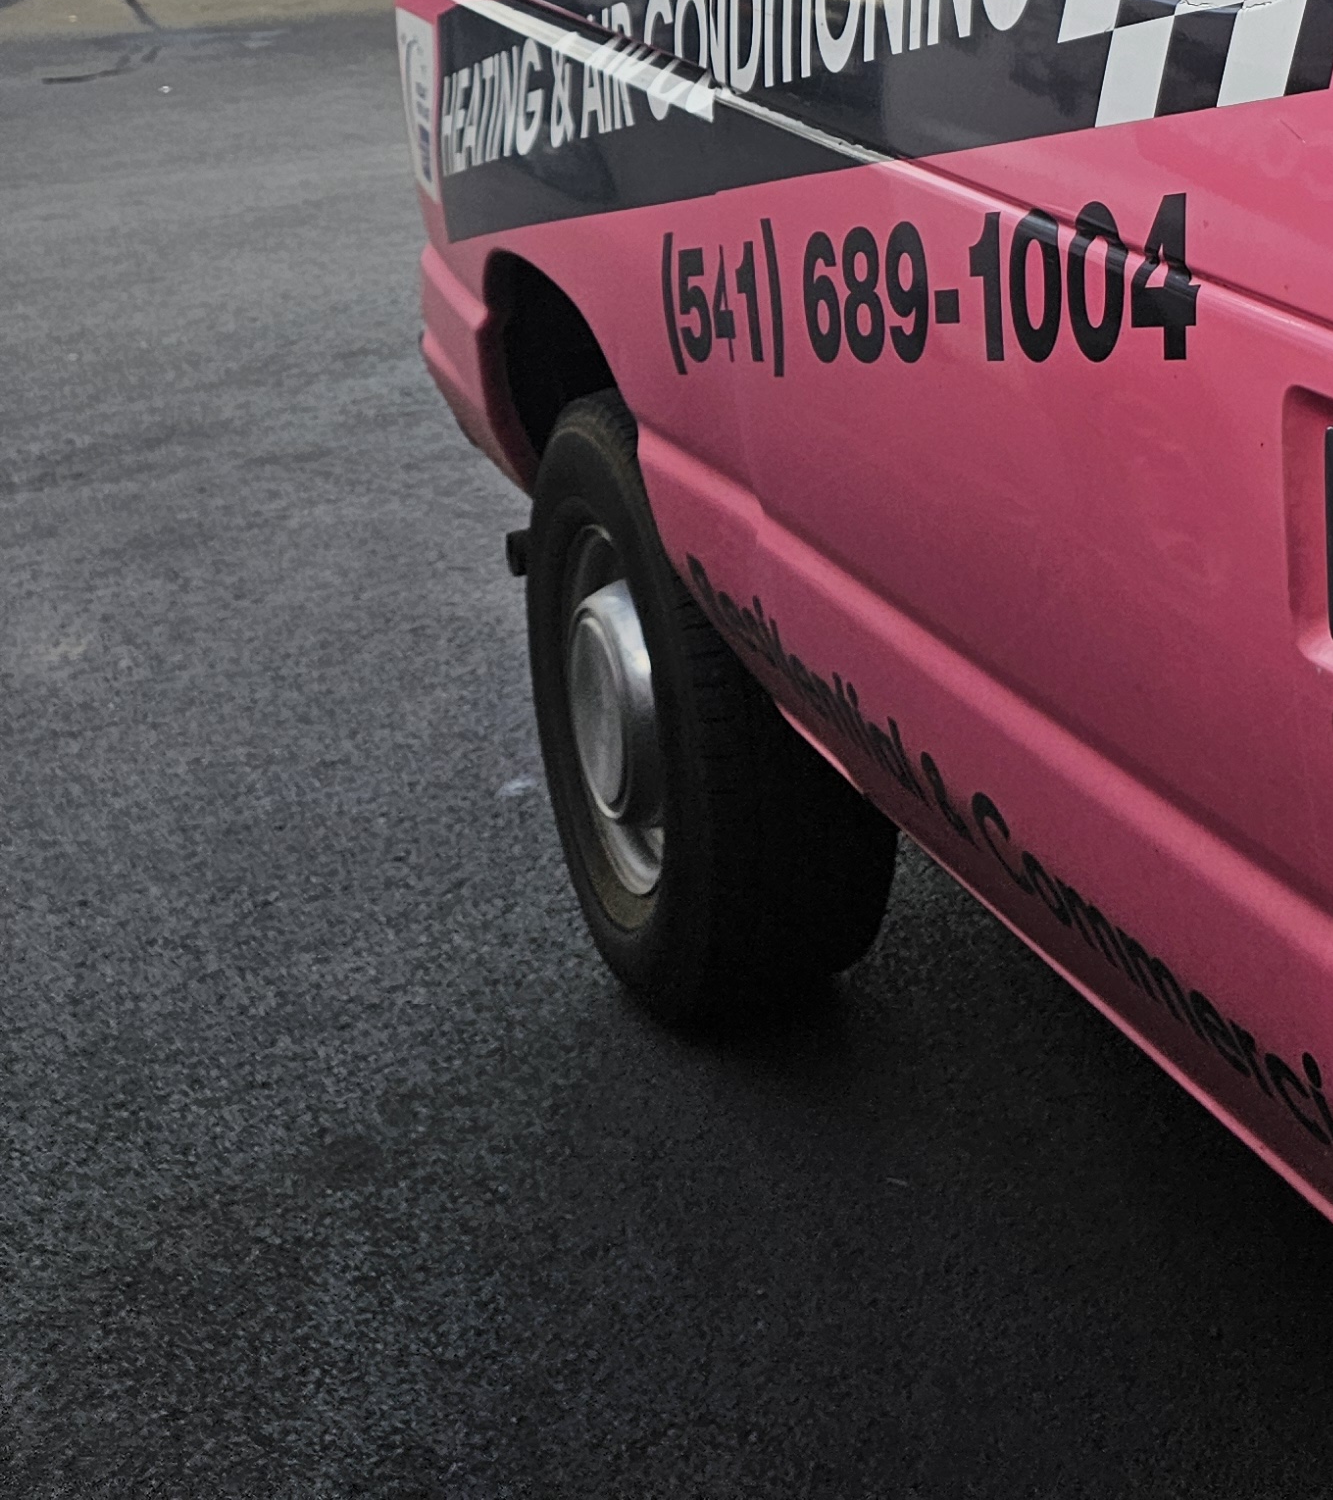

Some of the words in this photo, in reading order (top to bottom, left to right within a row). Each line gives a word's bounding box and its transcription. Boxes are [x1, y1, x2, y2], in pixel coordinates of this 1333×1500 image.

[440, 38, 545, 177] HEATING
[549, 40, 577, 149] &
[581, 2, 636, 138] AIR
[661, 217, 785, 378] (541)
[803, 193, 1201, 364] 689-1004
